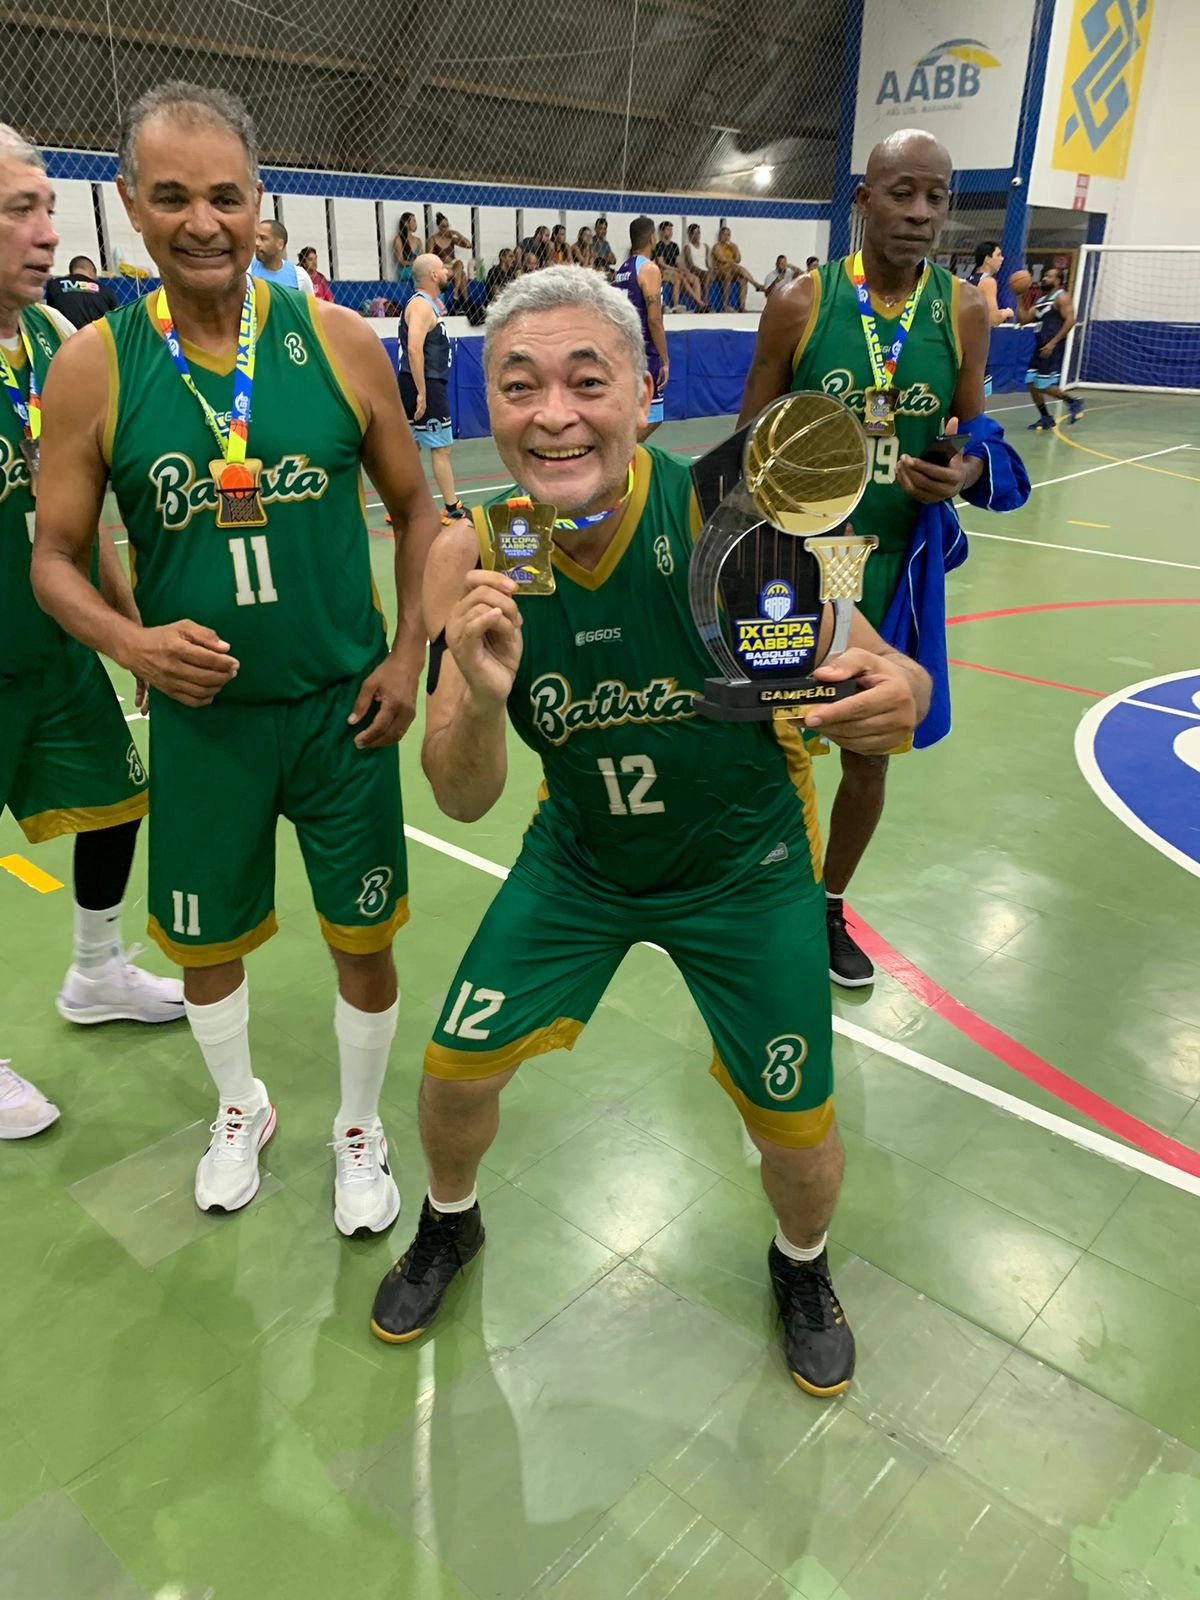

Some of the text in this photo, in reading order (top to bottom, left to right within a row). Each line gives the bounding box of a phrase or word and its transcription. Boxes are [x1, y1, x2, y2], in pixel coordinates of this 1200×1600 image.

[875, 63, 981, 105] AABB
[284, 332, 308, 365] B
[228, 535, 279, 606] 11
[653, 534, 674, 576] B
[740, 622, 813, 639] IX COPA
[745, 649, 808, 660] BASQUETE
[753, 657, 800, 667] MASTER
[530, 672, 706, 747] Batista
[760, 686, 837, 701] CAMPEÃO
[597, 754, 665, 815] 12
[172, 890, 201, 936] 11
[355, 866, 393, 918] B
[443, 980, 506, 1040] 12
[760, 1033, 808, 1102] B
